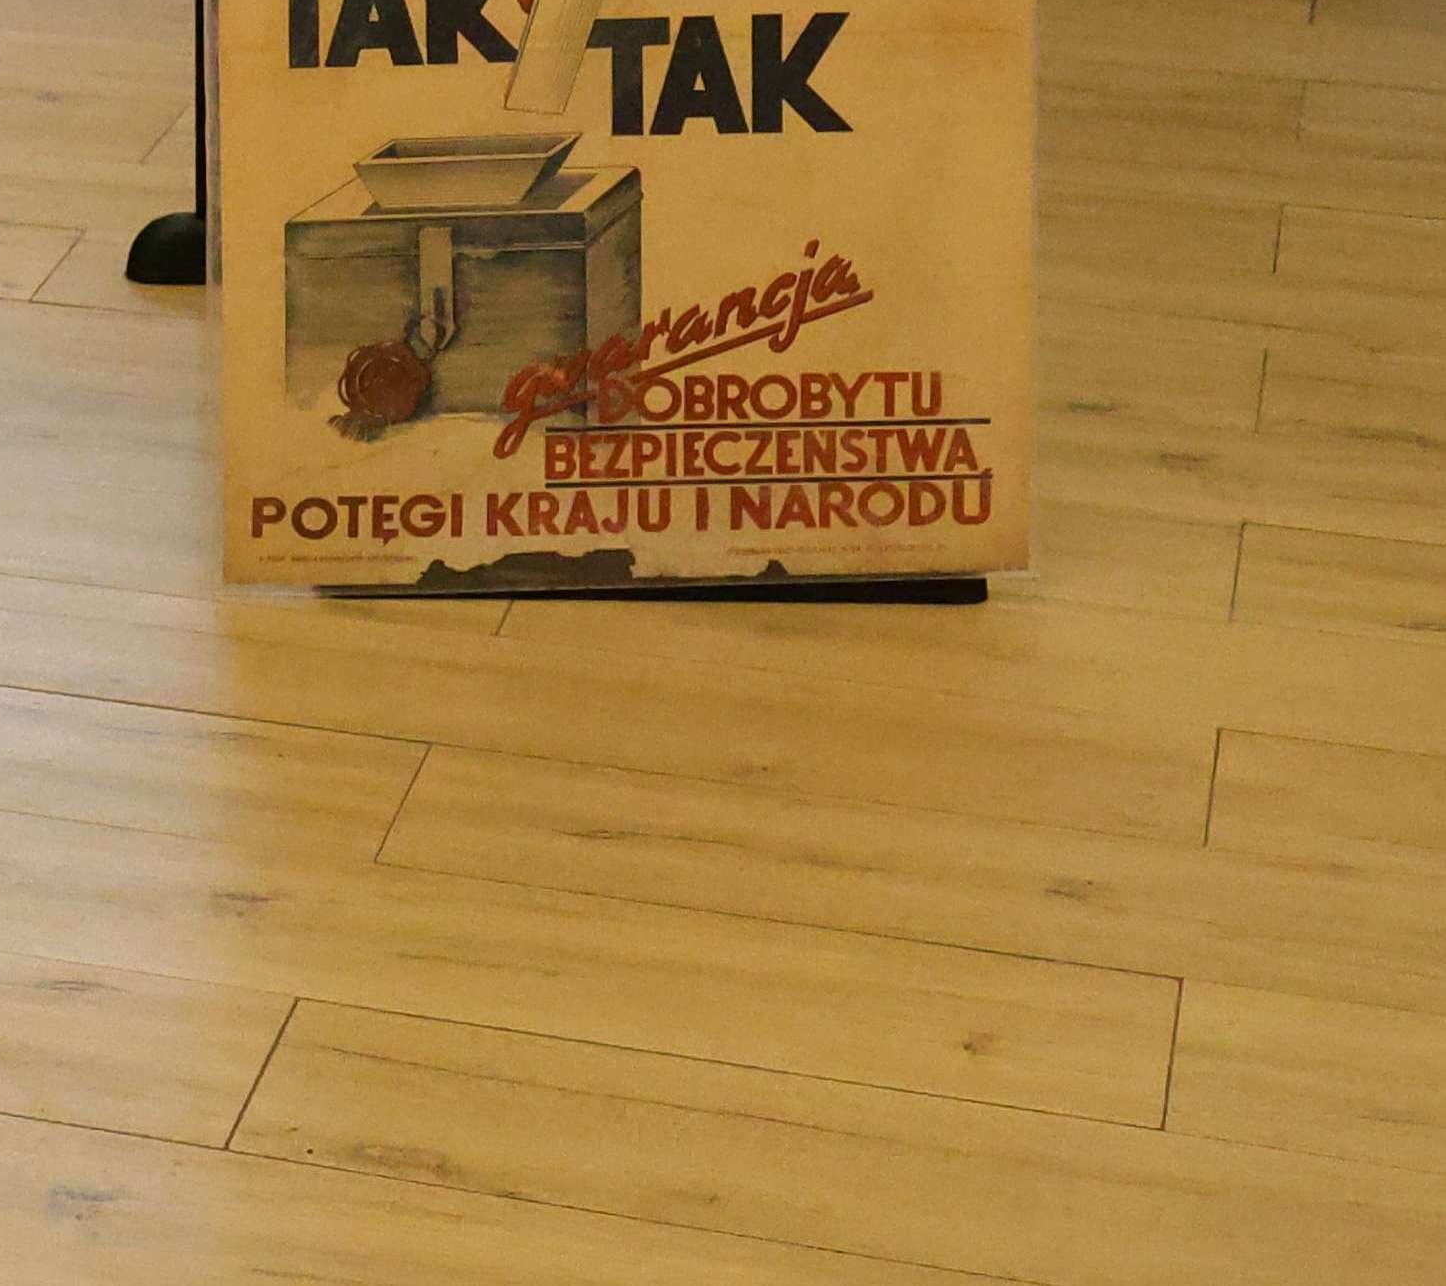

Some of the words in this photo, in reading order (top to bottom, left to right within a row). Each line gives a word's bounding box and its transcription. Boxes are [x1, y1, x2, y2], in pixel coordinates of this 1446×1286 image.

[586, 12, 854, 136] TAK
[595, 371, 942, 426] DOBROBYTU
[250, 492, 464, 546] POTĘGI
[485, 486, 673, 537] KRAJU
[694, 485, 710, 532] I
[729, 476, 993, 531] NARODU
